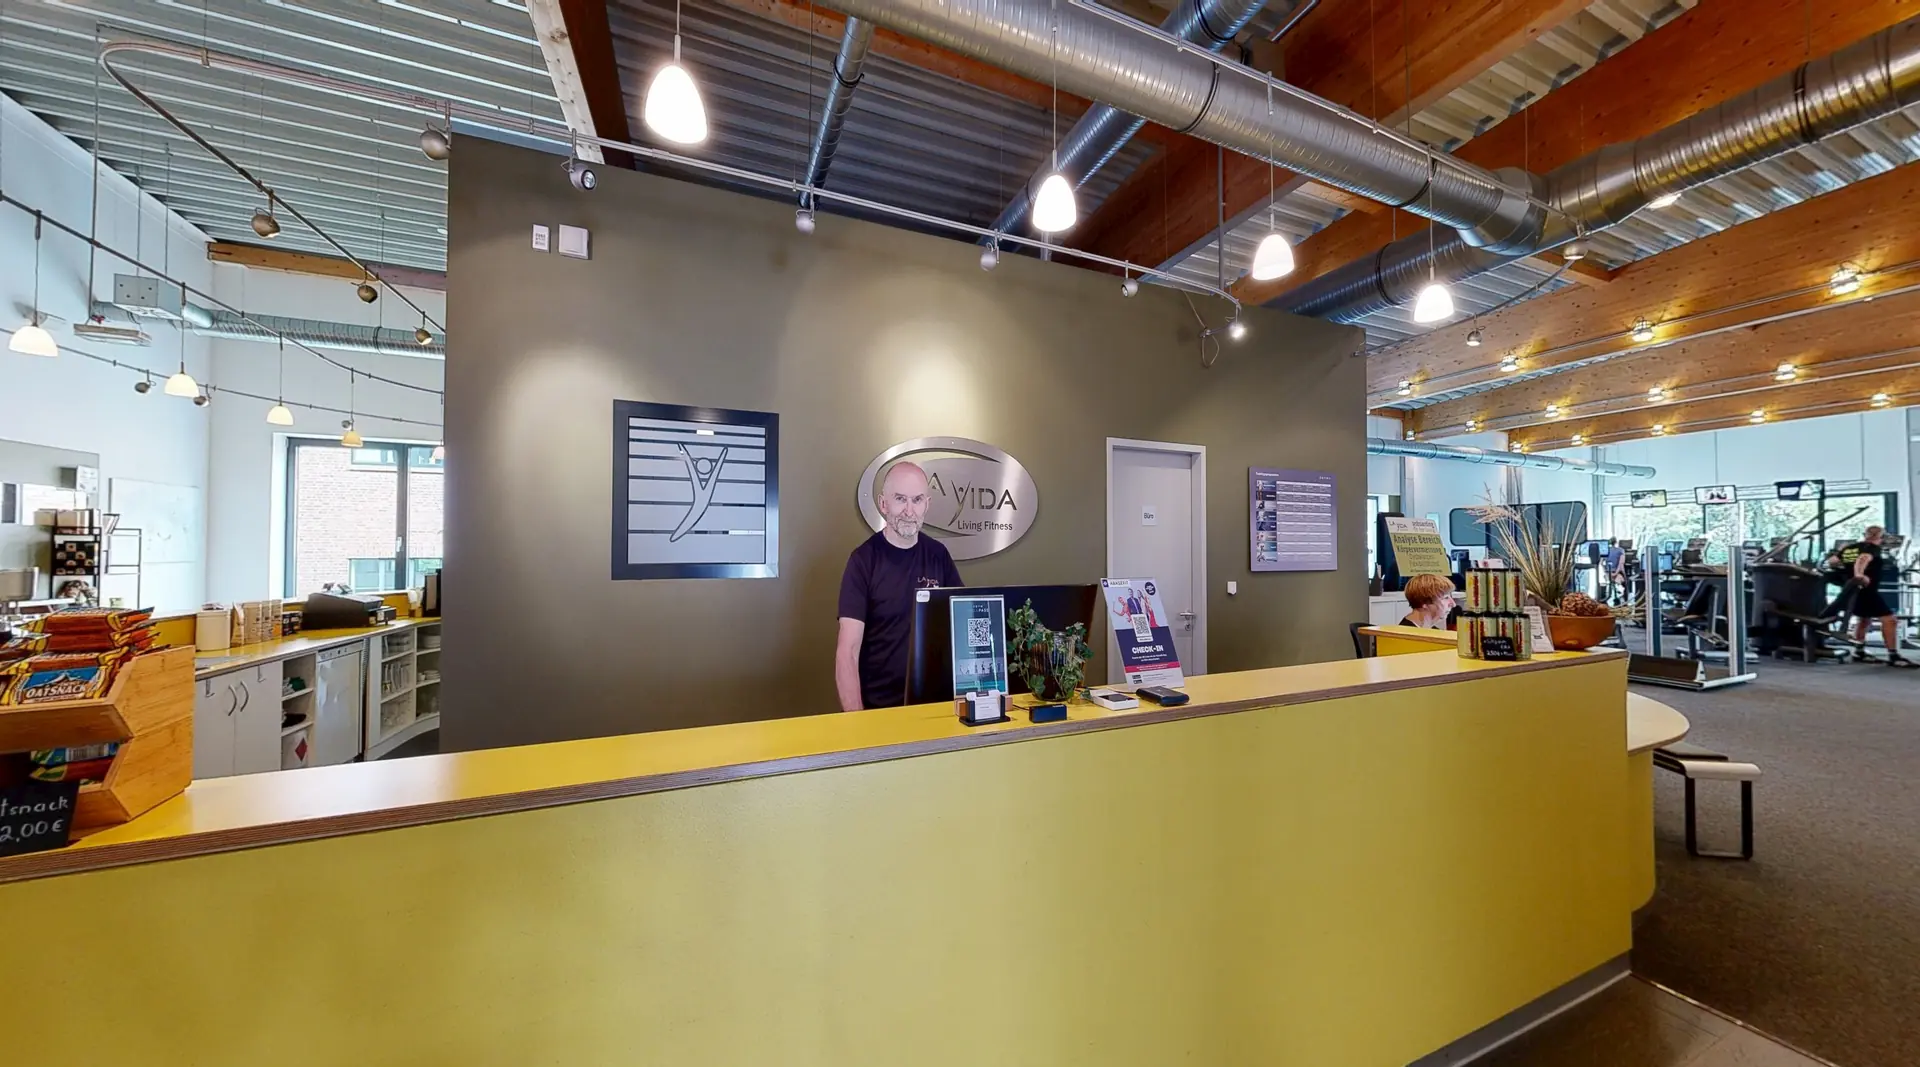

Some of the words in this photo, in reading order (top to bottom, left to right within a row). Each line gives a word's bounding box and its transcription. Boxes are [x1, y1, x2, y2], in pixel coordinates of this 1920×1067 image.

[1143, 512, 1155, 520] Büro
[957, 520, 982, 531] Living
[984, 520, 1013, 531] Fitness
[1393, 534, 1418, 546] Analyse
[1418, 534, 1441, 545] Bereich
[1131, 644, 1164, 654] CHECK-IN
[26, 682, 87, 700] OATSNACK
